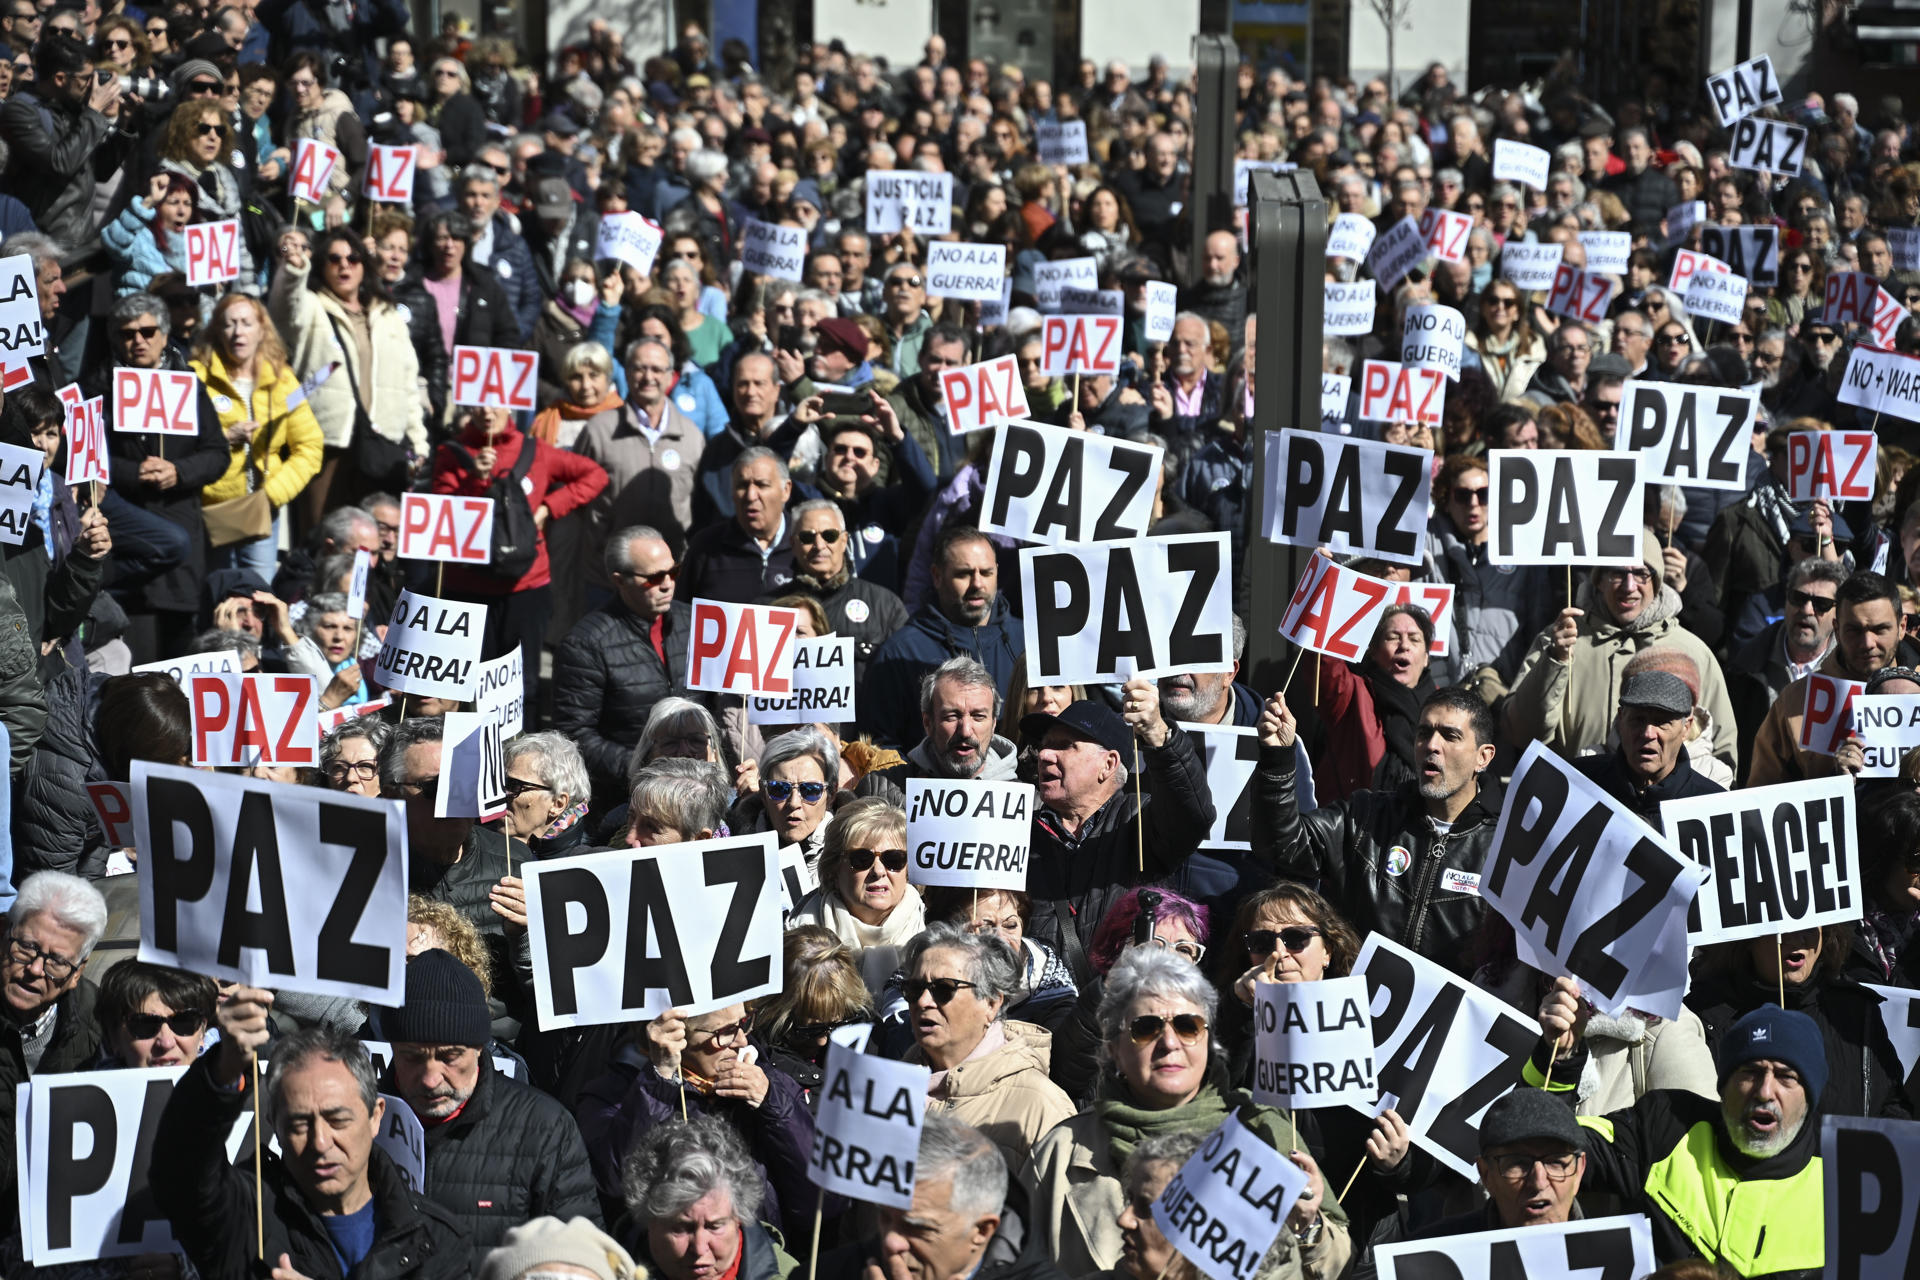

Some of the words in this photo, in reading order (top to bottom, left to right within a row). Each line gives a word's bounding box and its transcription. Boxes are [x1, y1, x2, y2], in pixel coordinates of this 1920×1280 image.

[1710, 59, 1778, 119] PAZ
[290, 142, 337, 200] AZ
[1733, 120, 1804, 172] PAZ
[874, 179, 943, 200] JUSTICIA
[875, 206, 882, 224] Y
[187, 224, 237, 281] PAZ
[931, 246, 962, 263] ¡NO
[966, 249, 976, 263] A
[980, 251, 998, 264] LA
[1076, 266, 1094, 279] LA
[1702, 228, 1775, 280] PAZ
[0, 274, 33, 304] A
[931, 274, 999, 291] GUERRA!
[1549, 266, 1610, 321] PAZ
[1685, 295, 1742, 320] GUERRA!
[1719, 278, 1727, 291] A
[1732, 282, 1746, 297] LA
[1824, 274, 1880, 326] PAZ
[1043, 318, 1119, 370] PAZ
[1405, 313, 1437, 336] ¡NO
[1441, 318, 1453, 332] A
[117, 371, 194, 431] PAZ
[454, 349, 535, 407] PAZ
[943, 359, 1026, 430] PAZ
[1362, 364, 1444, 422] PAZ
[1848, 359, 1873, 390] NO
[1875, 369, 1884, 389] +
[1886, 367, 1920, 404] WAR
[1628, 388, 1751, 481] PAZ
[990, 424, 1154, 541] PAZ
[1789, 433, 1873, 498] PAZ
[1282, 434, 1425, 557] PAZ
[1499, 456, 1637, 557] PAZ
[402, 497, 488, 558] PAZ
[408, 605, 429, 632] A
[434, 609, 469, 637] LA
[1032, 540, 1223, 677] PAZ
[1280, 552, 1389, 659] PAZ
[377, 642, 472, 685] GUERRA!
[691, 603, 796, 693] PAZ
[793, 647, 810, 669] A
[815, 644, 844, 669] LA
[479, 664, 509, 699] ¡NO
[753, 685, 850, 712] GUERRA!
[192, 676, 313, 763] PAZ
[1802, 676, 1866, 752] PA
[1856, 706, 1903, 732] ¡NO
[910, 788, 967, 824] ¡NO
[972, 789, 994, 819] A
[1001, 790, 1026, 821] LA
[146, 775, 391, 990] PAZ
[915, 841, 1027, 876] GUERRA!
[1488, 754, 1685, 1000] PAZ
[1677, 796, 1852, 934] PEACE!
[538, 844, 771, 1017] PAZ
[1283, 1002, 1307, 1034] A
[1316, 998, 1366, 1032] LA
[1258, 1056, 1375, 1095] GUERRA!
[1365, 945, 1541, 1167] PAZ
[828, 1068, 853, 1110] A
[863, 1078, 916, 1128] LA
[1211, 1148, 1241, 1187] A
[1239, 1166, 1285, 1223] LA
